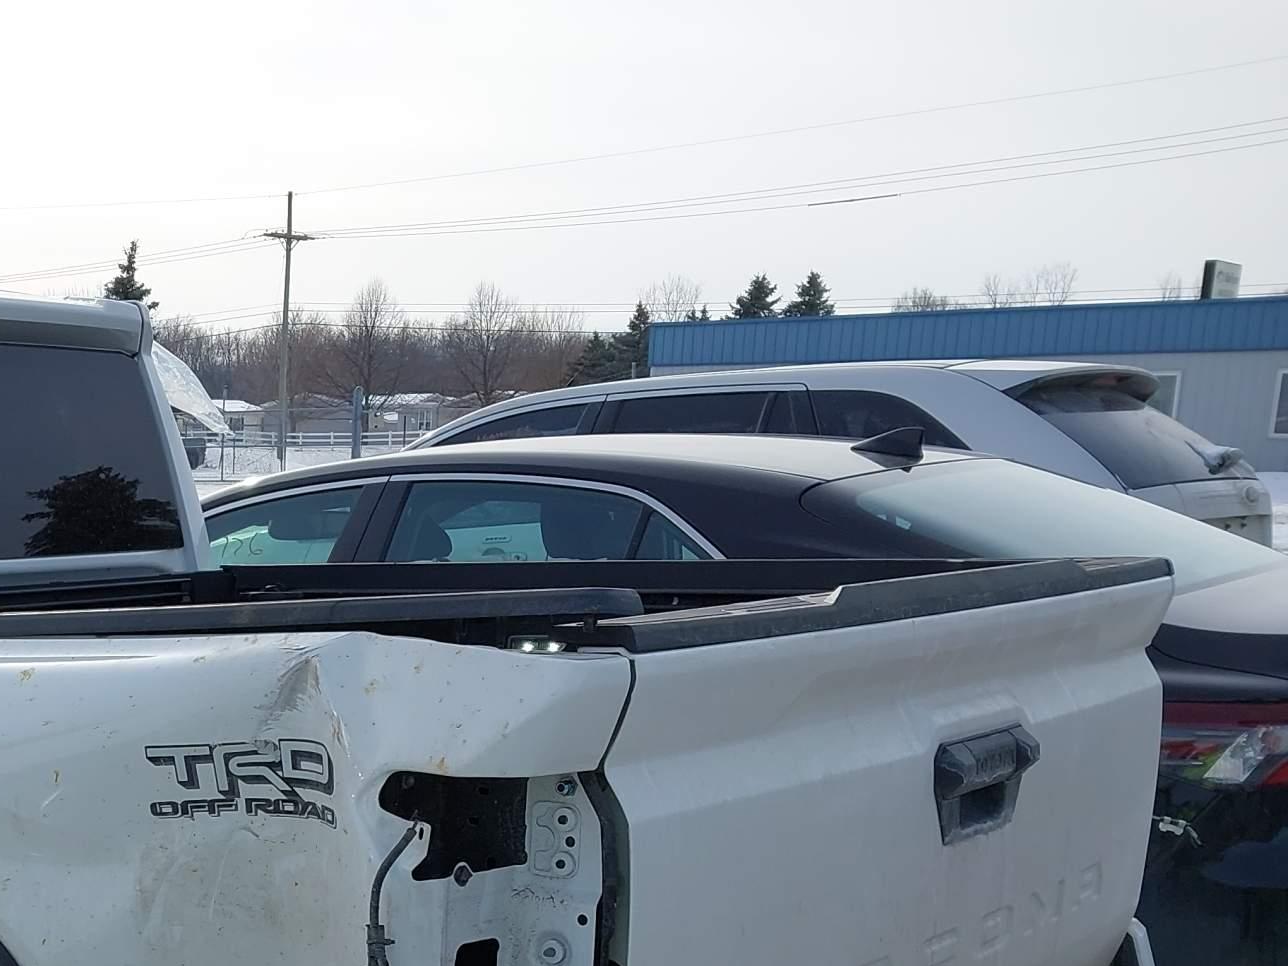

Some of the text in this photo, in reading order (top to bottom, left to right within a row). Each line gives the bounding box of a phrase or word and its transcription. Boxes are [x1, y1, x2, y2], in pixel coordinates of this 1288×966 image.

[145, 738, 335, 800] TRD
[150, 798, 338, 829] OFF ROAD
